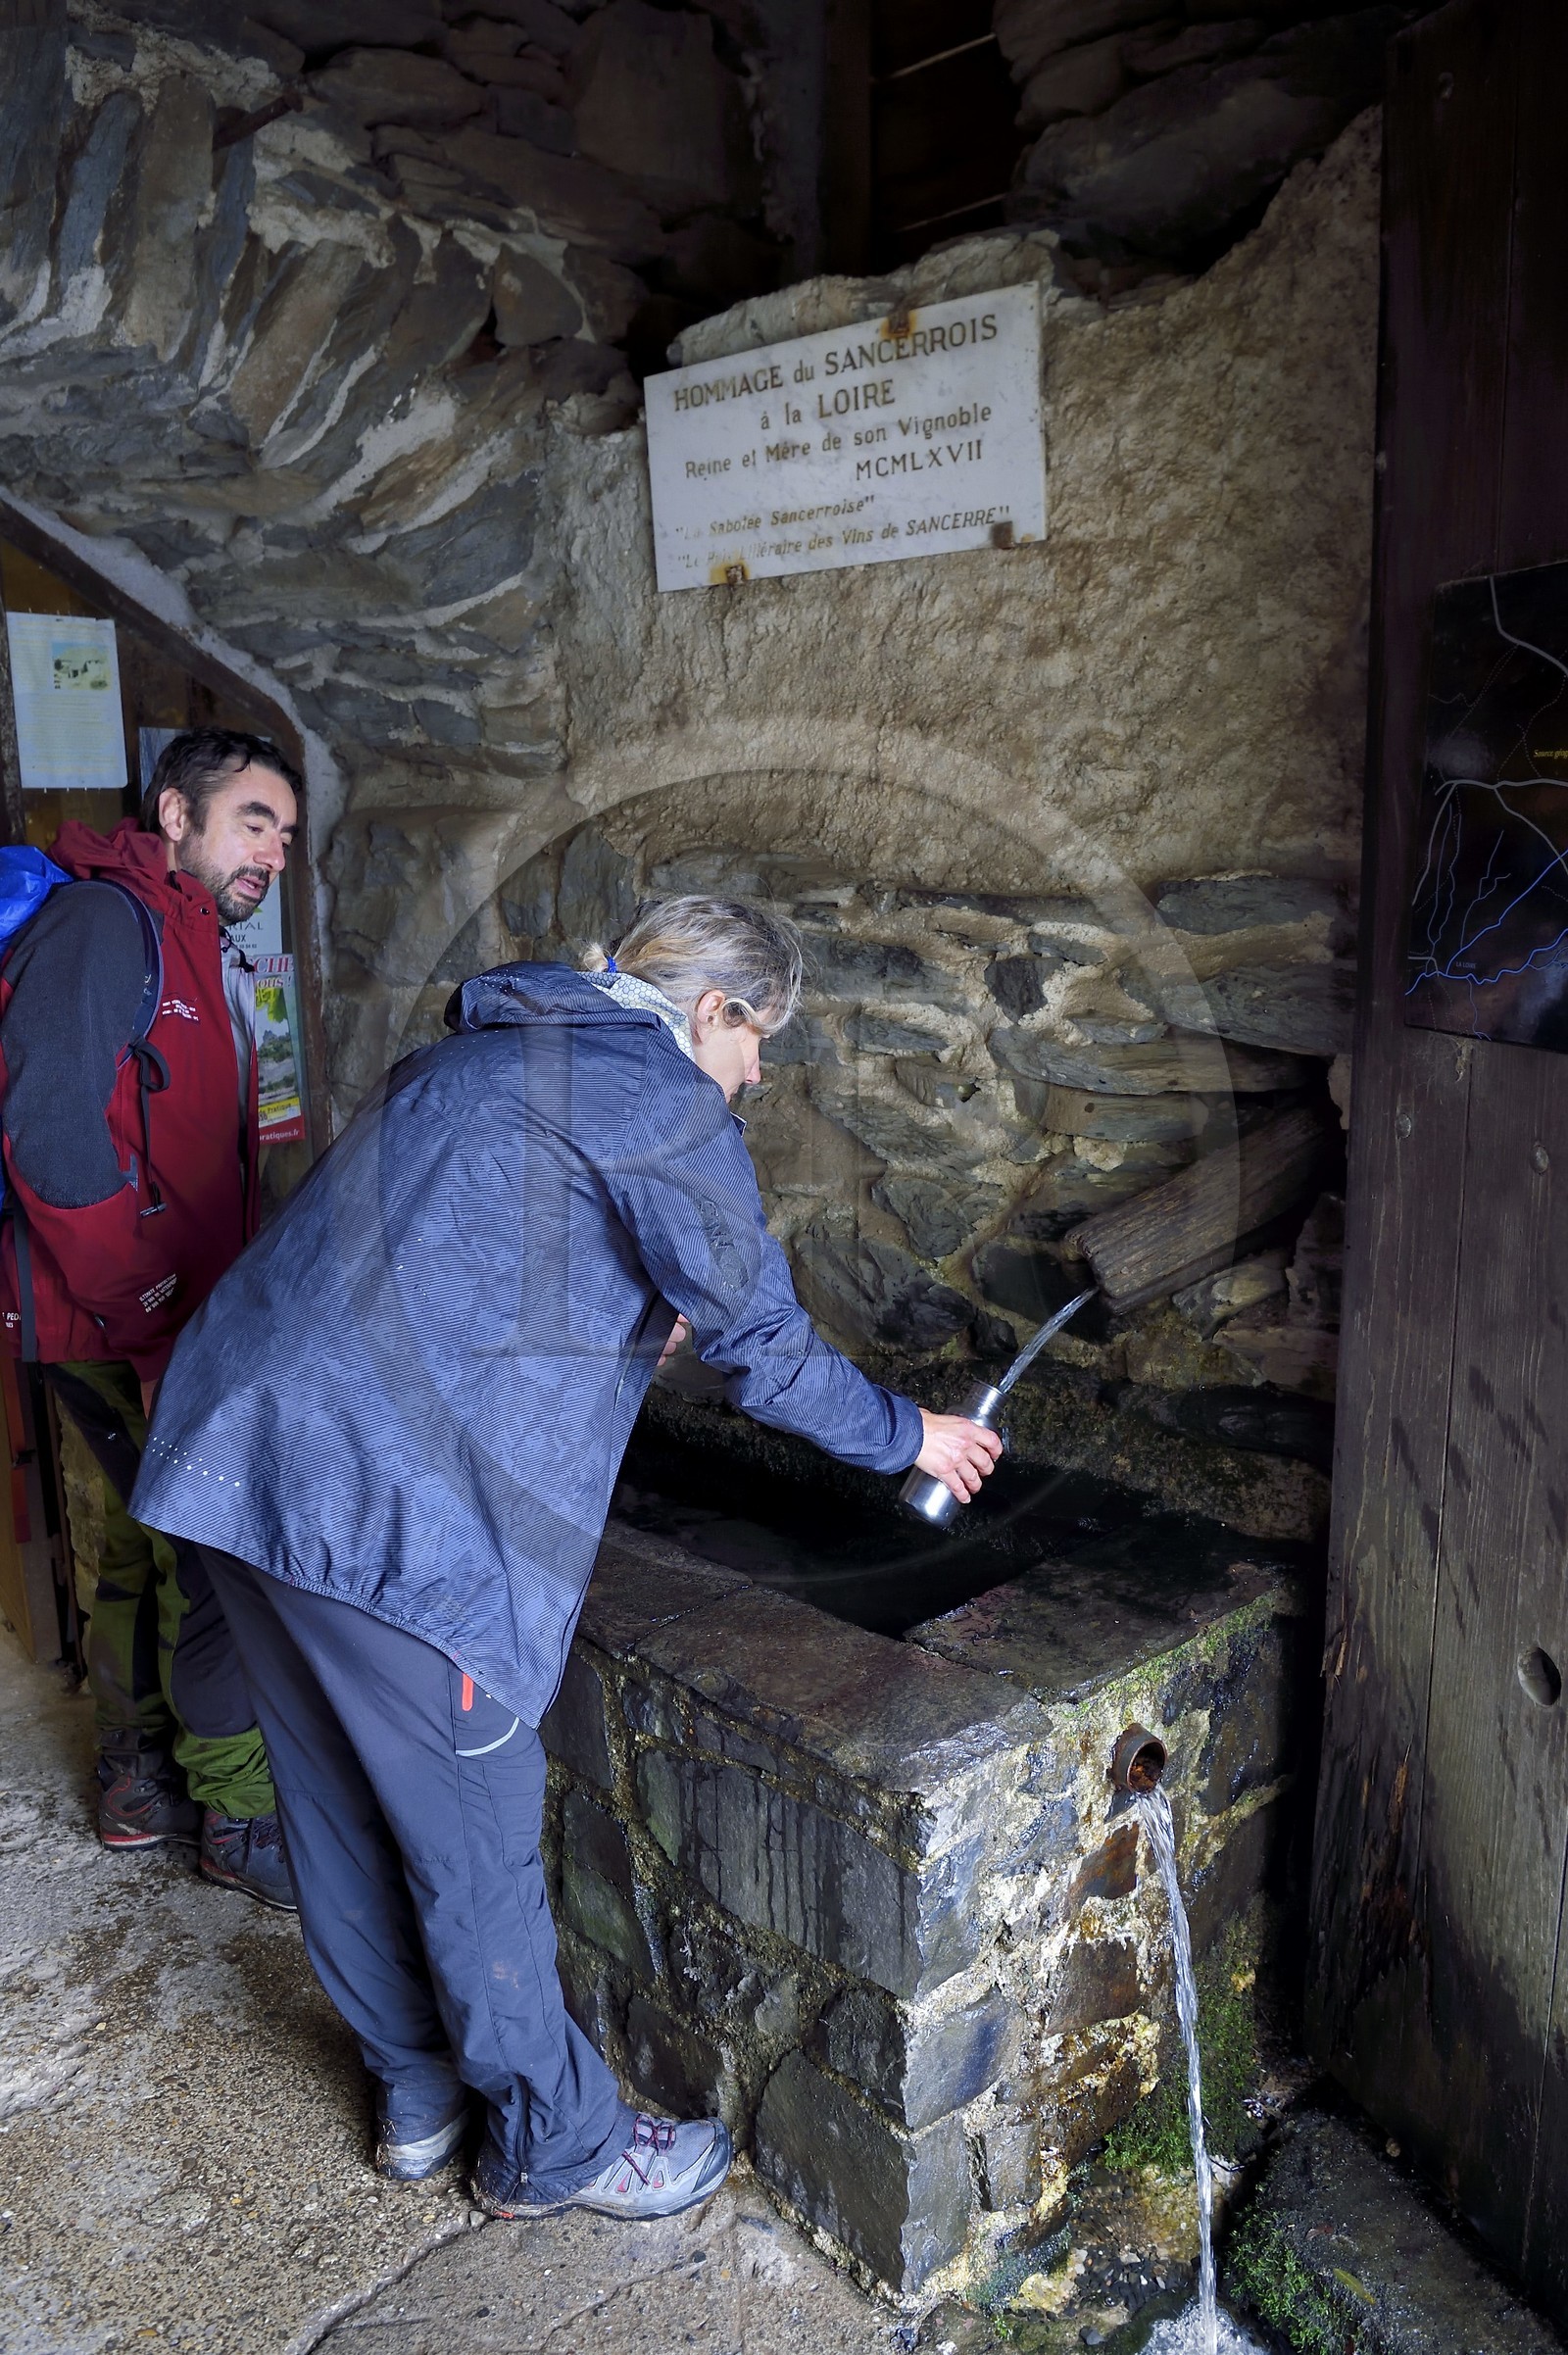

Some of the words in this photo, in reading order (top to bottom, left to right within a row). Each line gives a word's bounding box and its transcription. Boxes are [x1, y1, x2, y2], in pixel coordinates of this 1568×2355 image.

[673, 365, 784, 412] HOMMAGE
[794, 360, 815, 383] du
[825, 314, 998, 375] SANCERROIS
[785, 402, 803, 425] la
[818, 378, 896, 418] LOIRE
[685, 458, 731, 479] Reine
[742, 449, 756, 468] et
[822, 432, 842, 452] de
[854, 427, 887, 446] son
[898, 403, 992, 439] Vignoble
[856, 439, 983, 481] MCMLXVII
[770, 495, 874, 526] Sancerroise"
[808, 533, 833, 551] des
[843, 528, 874, 545] Vins
[882, 522, 899, 539] de
